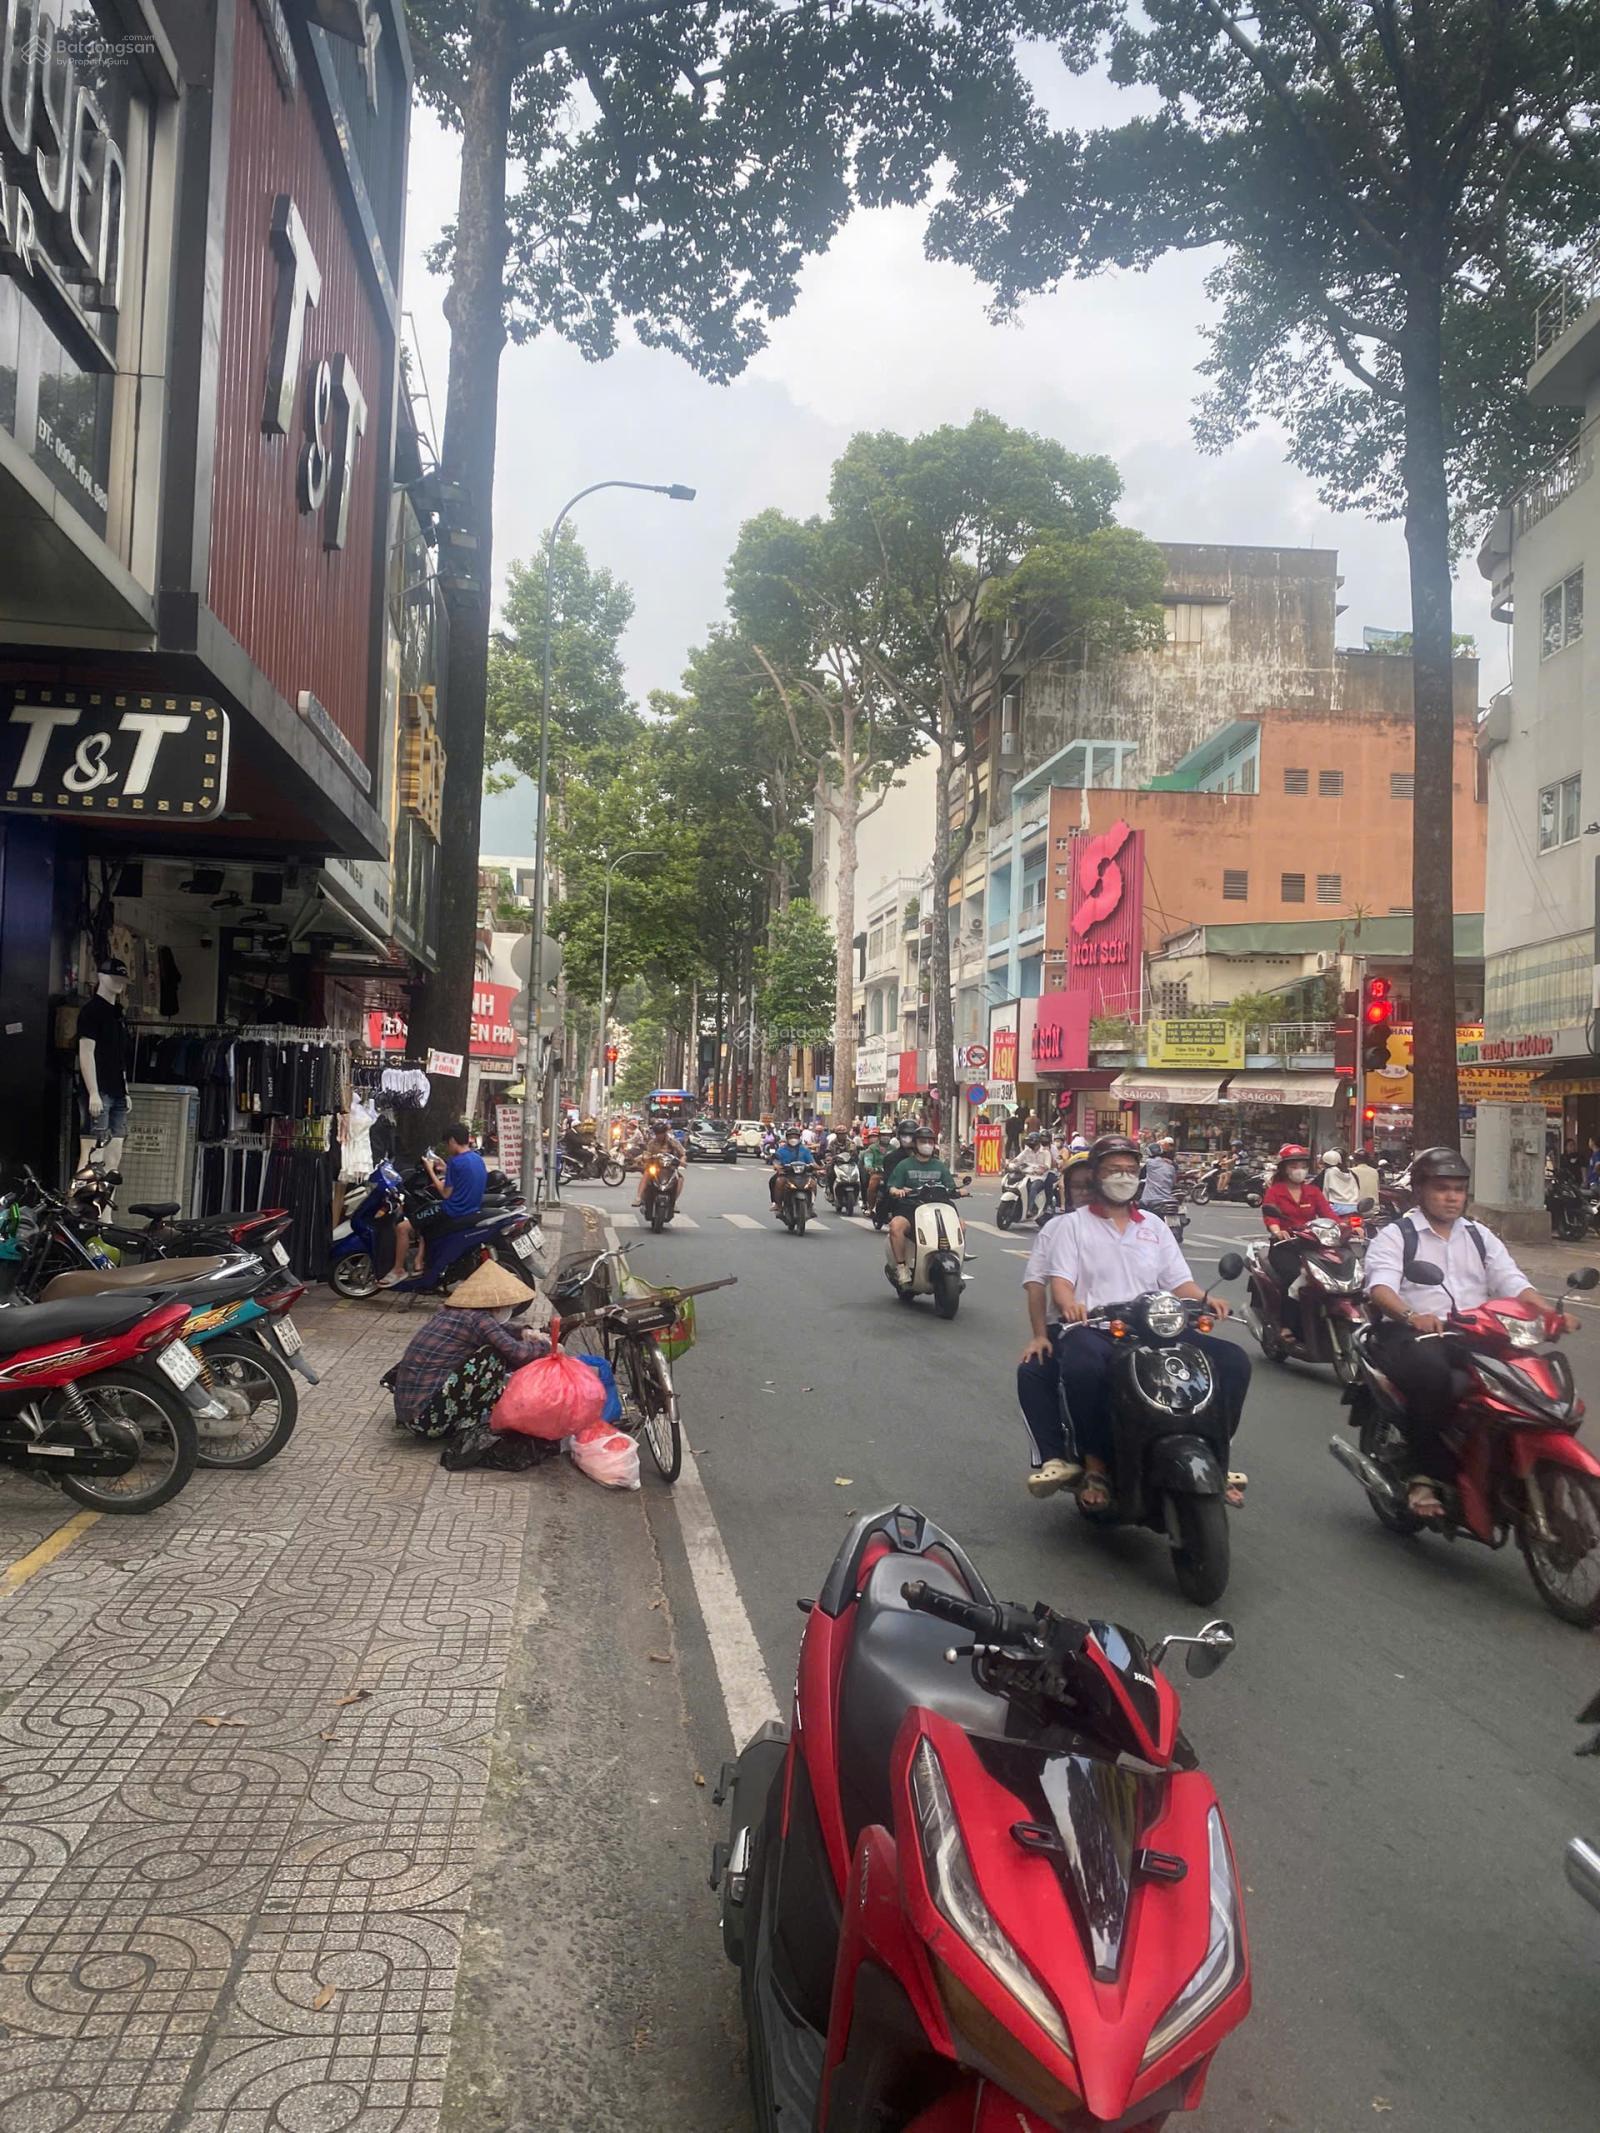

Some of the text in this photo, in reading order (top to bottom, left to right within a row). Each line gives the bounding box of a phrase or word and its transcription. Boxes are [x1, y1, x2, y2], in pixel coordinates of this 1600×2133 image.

[994, 1046, 1015, 1079] 49K
[1123, 1089, 1161, 1099] SAIGON
[1241, 1092, 1281, 1102] SAIGON
[978, 1139, 999, 1173] 49K
